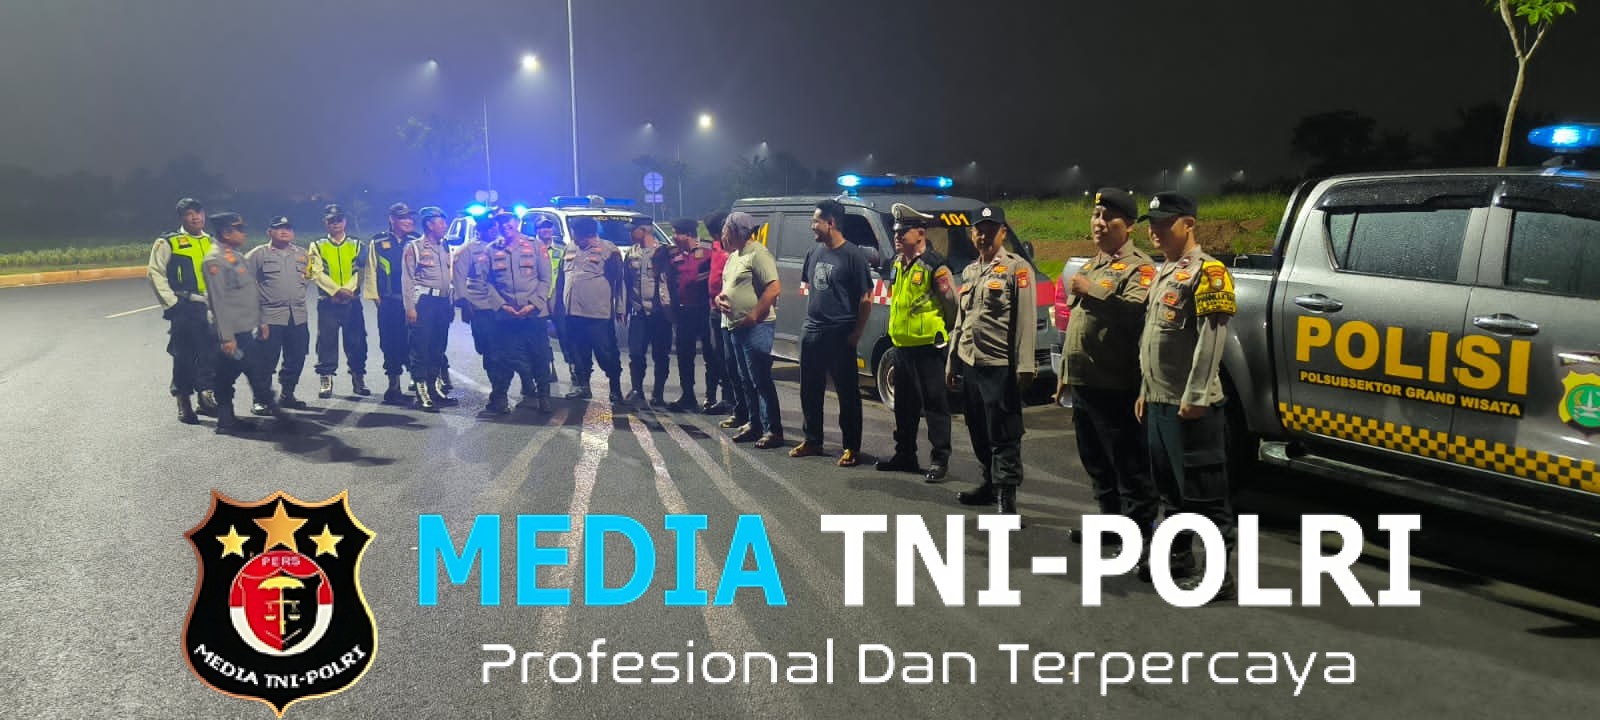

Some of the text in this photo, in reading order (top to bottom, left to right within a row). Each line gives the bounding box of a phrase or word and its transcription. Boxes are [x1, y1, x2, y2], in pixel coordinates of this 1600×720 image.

[940, 213, 970, 227] 101
[1295, 315, 1532, 396] POLISI
[1300, 370, 1521, 417] POLSUBSEKTOR GRAND WISATA
